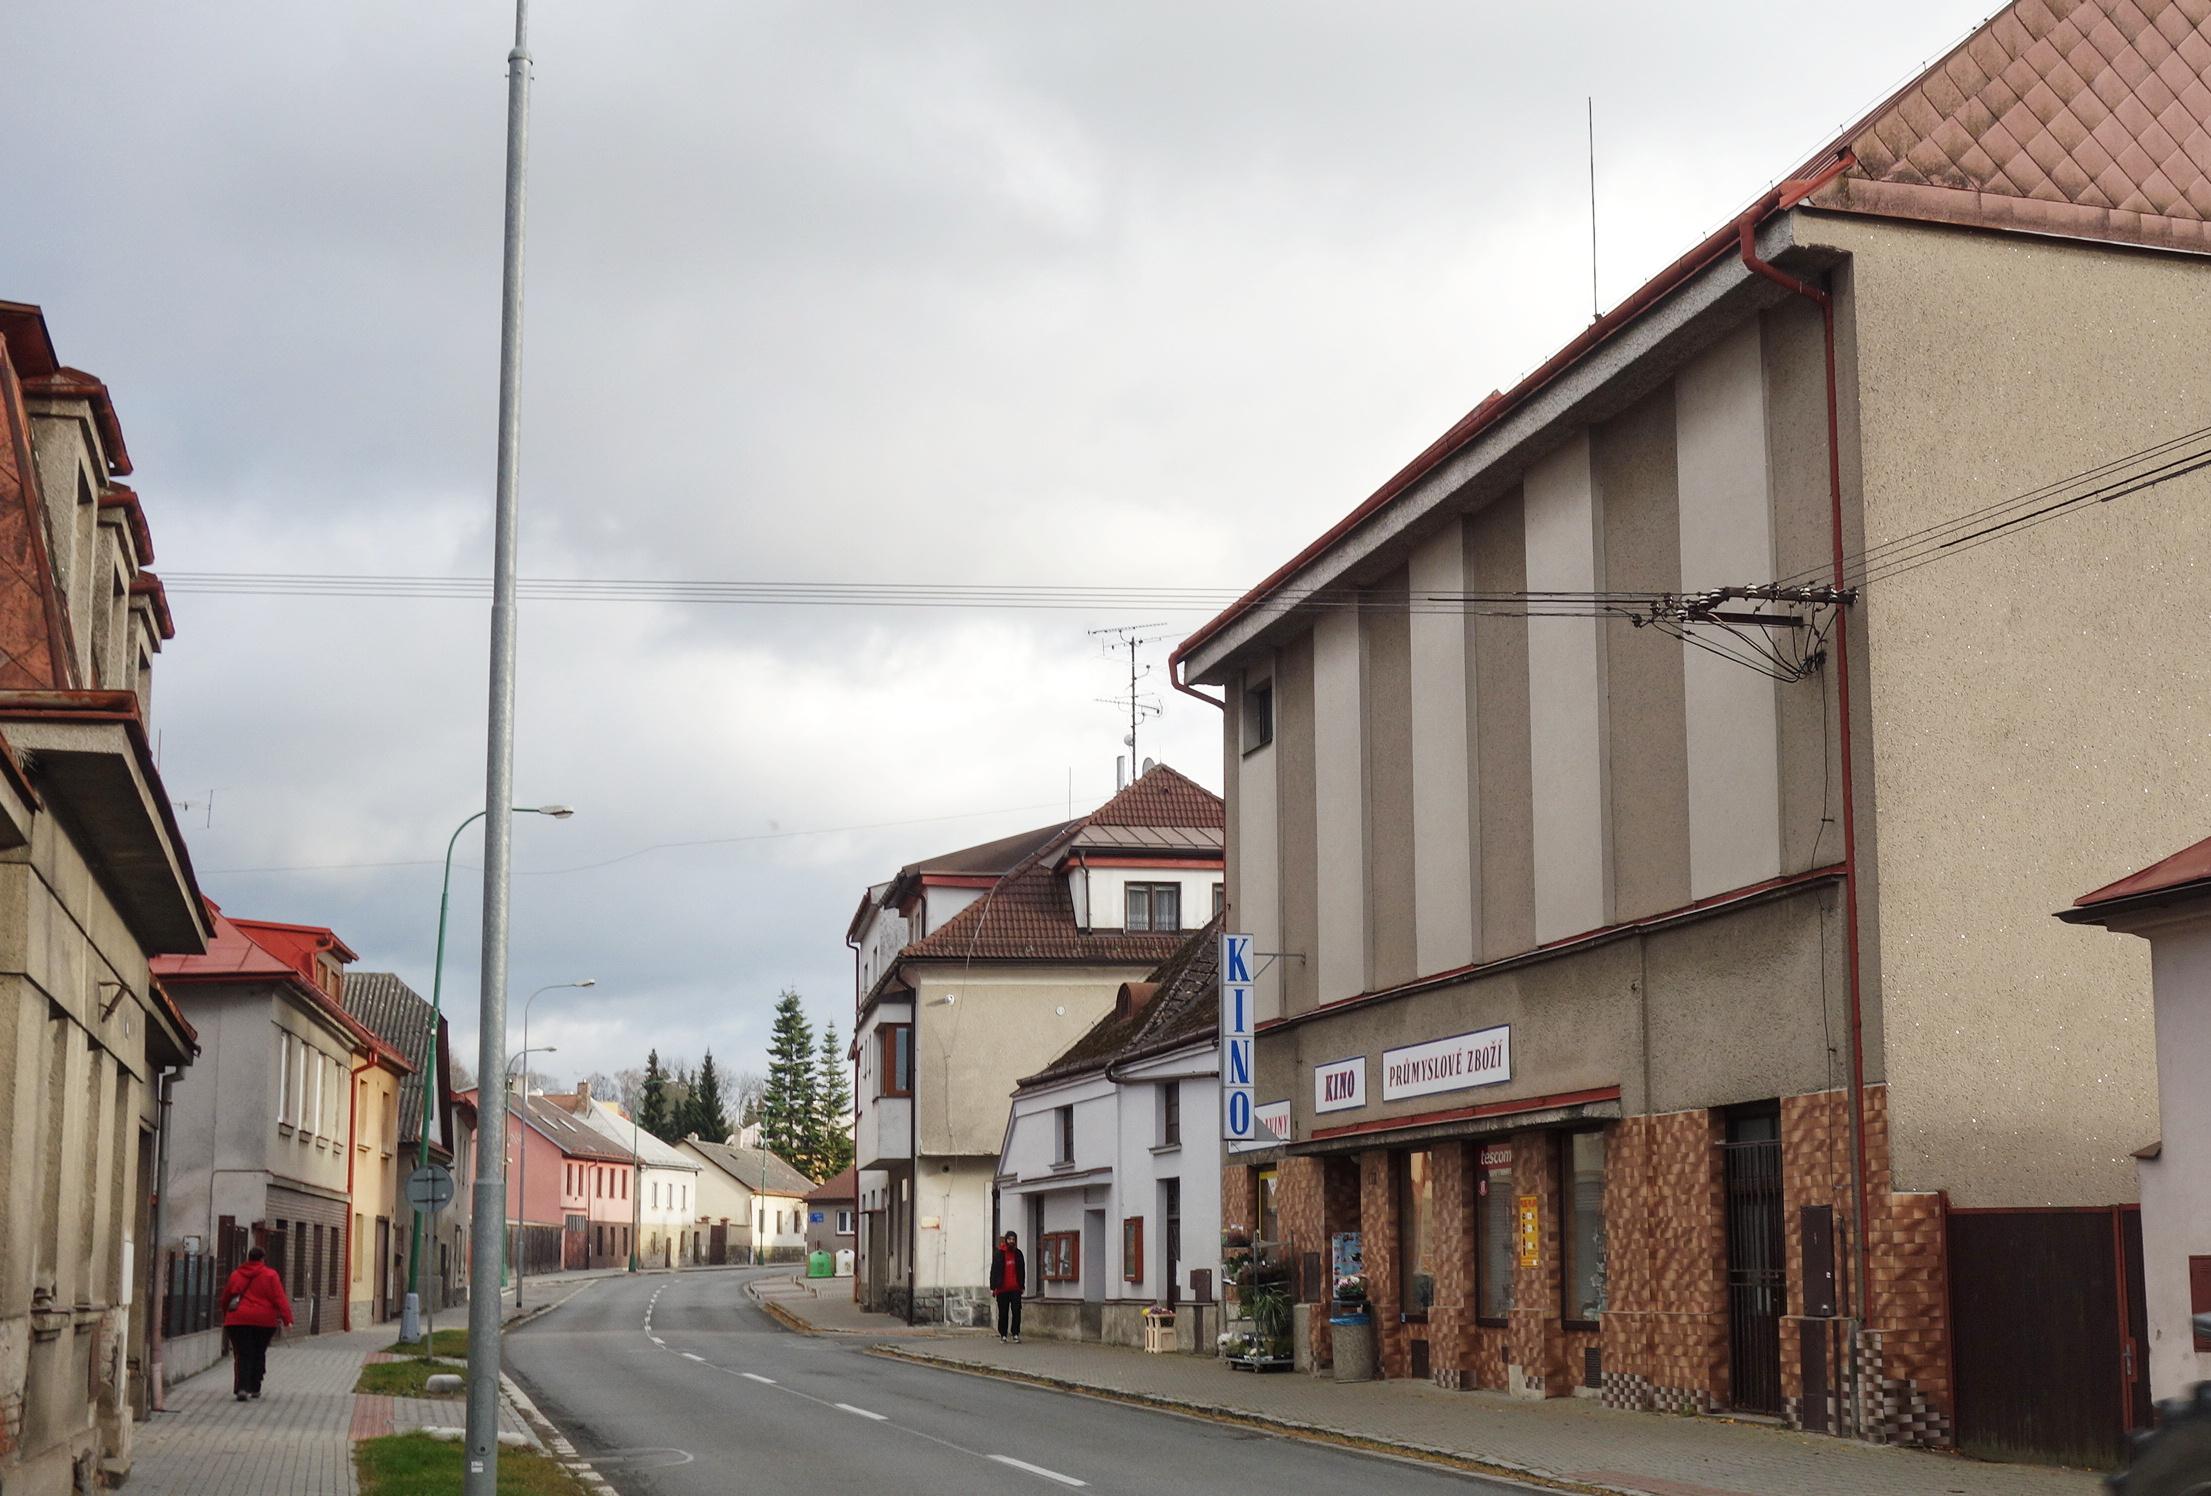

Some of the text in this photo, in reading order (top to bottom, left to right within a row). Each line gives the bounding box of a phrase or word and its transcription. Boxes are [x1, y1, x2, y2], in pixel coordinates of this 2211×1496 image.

[1227, 938, 1250, 1135] KINO
[1325, 1069, 1355, 1102] KINO
[1389, 1040, 1503, 1087] PRŮMYSLOVÉ ZBOŽÍ
